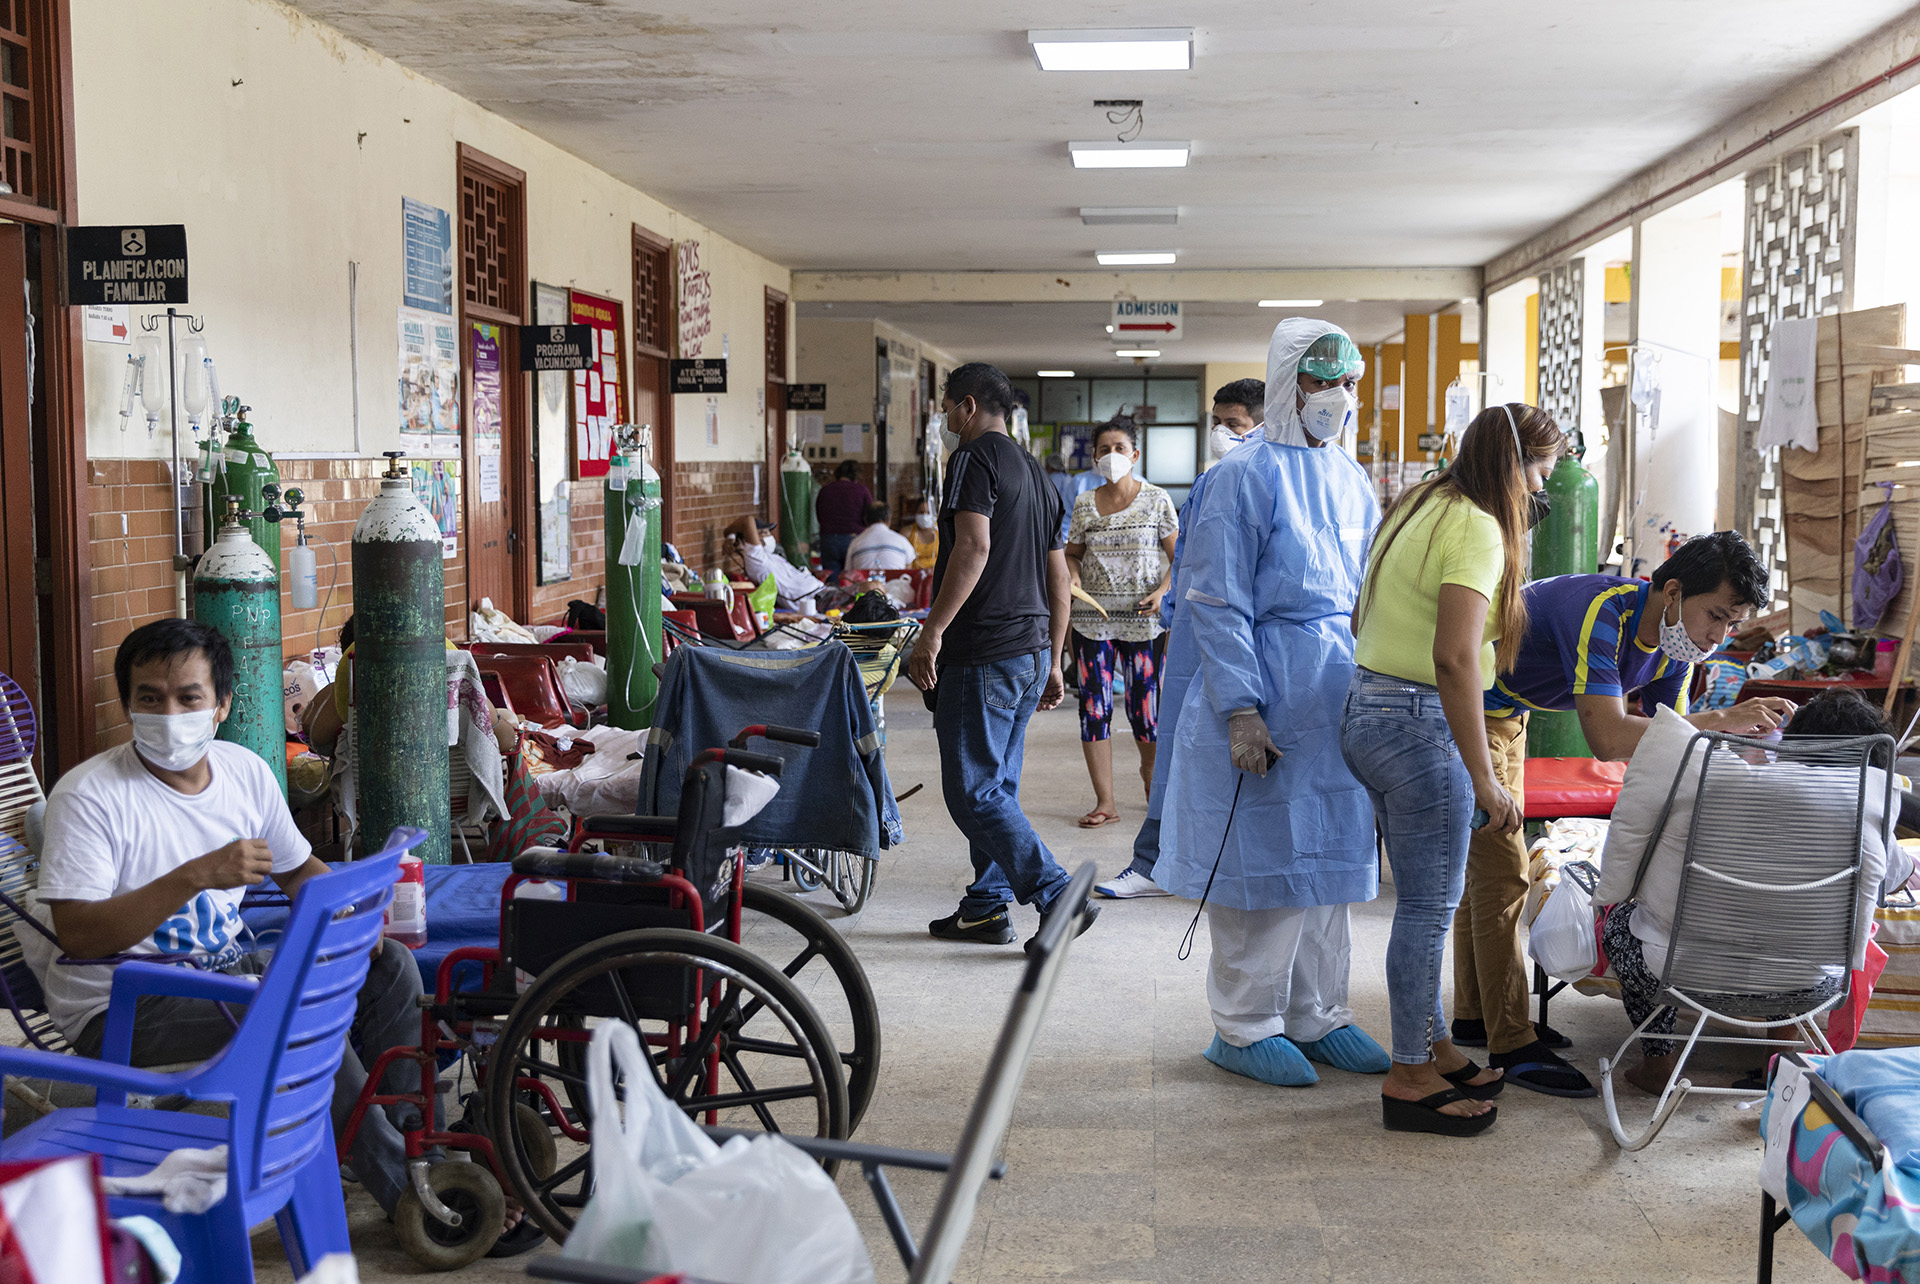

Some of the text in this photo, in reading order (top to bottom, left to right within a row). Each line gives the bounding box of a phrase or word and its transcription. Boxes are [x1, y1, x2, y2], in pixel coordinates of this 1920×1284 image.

[82, 258, 185, 280] PLANIFICACION
[103, 281, 167, 302] FAMILIAR
[1117, 301, 1178, 316] ADMISION
[536, 343, 580, 356] PROGRAMA
[534, 356, 583, 369] VACUNACION
[680, 368, 720, 377] ATENCION
